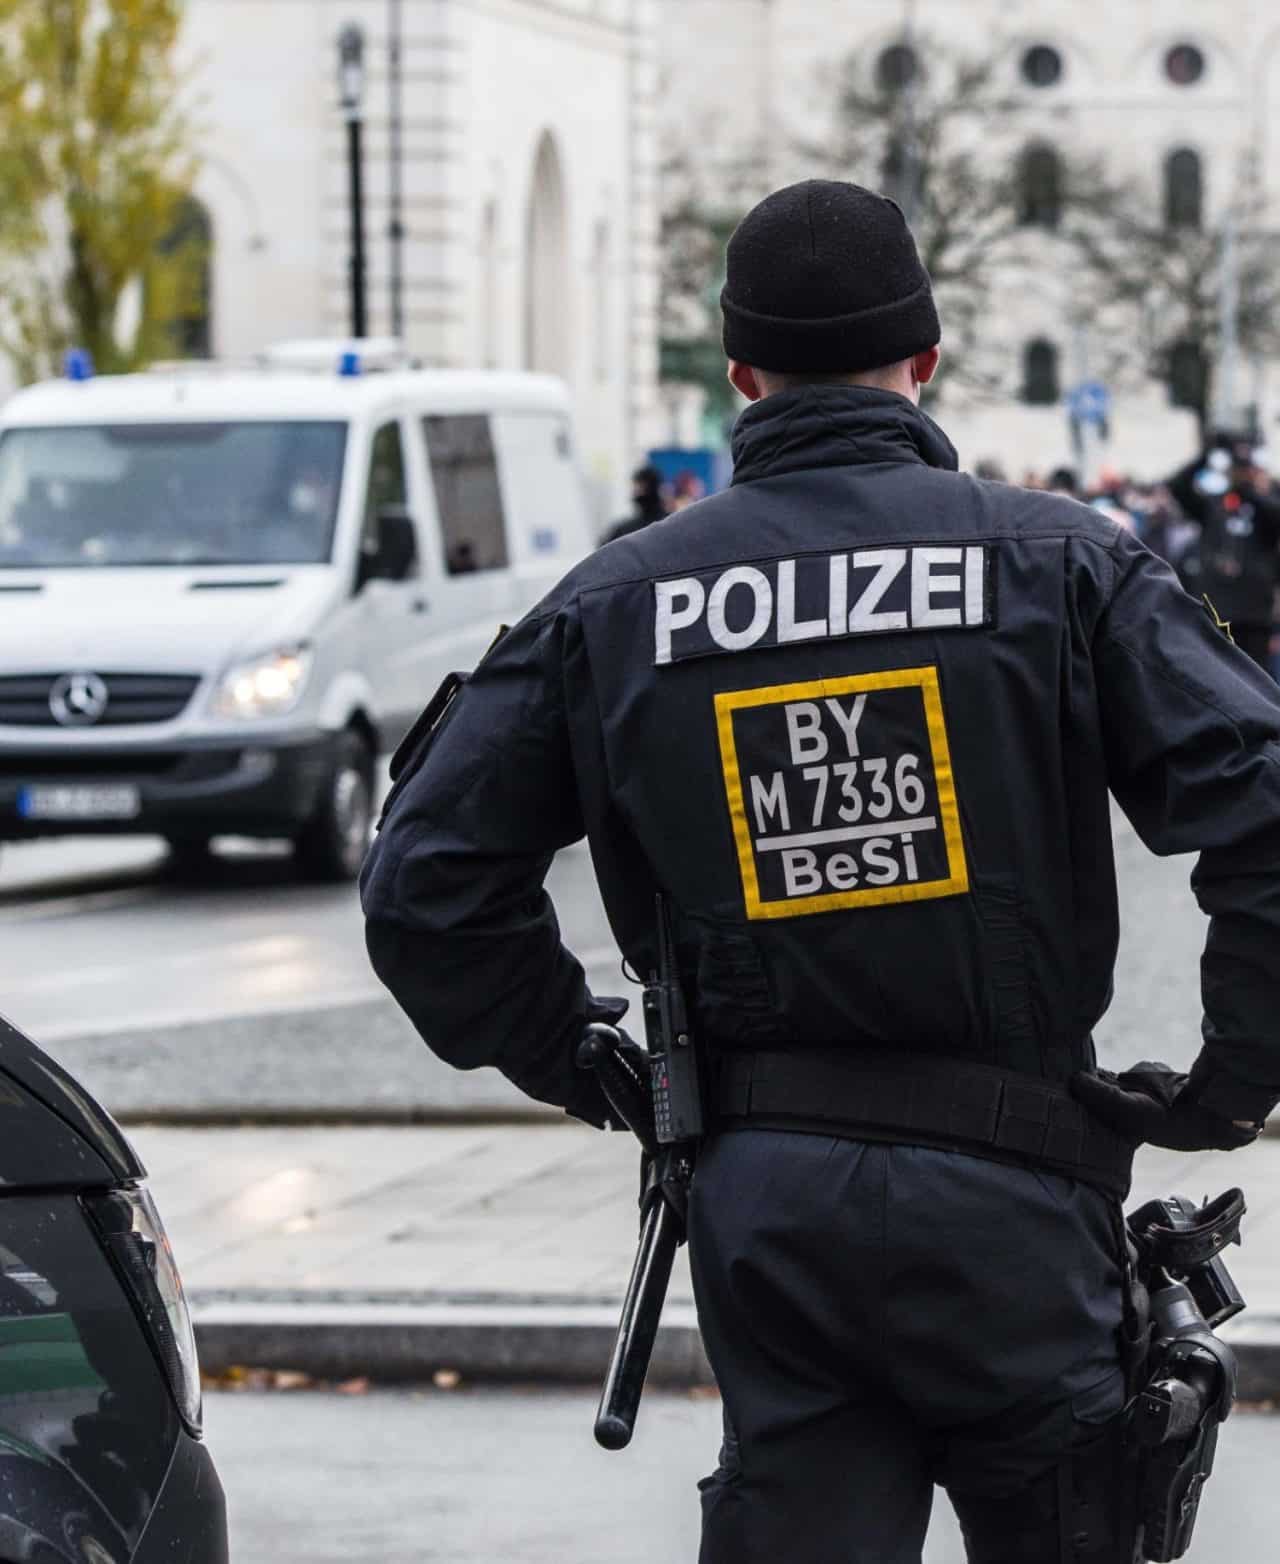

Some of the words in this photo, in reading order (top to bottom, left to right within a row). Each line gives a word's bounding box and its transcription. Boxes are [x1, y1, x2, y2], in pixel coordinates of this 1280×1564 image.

[655, 546, 984, 665] POLIZEI
[784, 694, 868, 766] BY
[750, 771, 791, 834] M
[802, 753, 926, 827] 7336
[782, 833, 919, 897] BeSi
